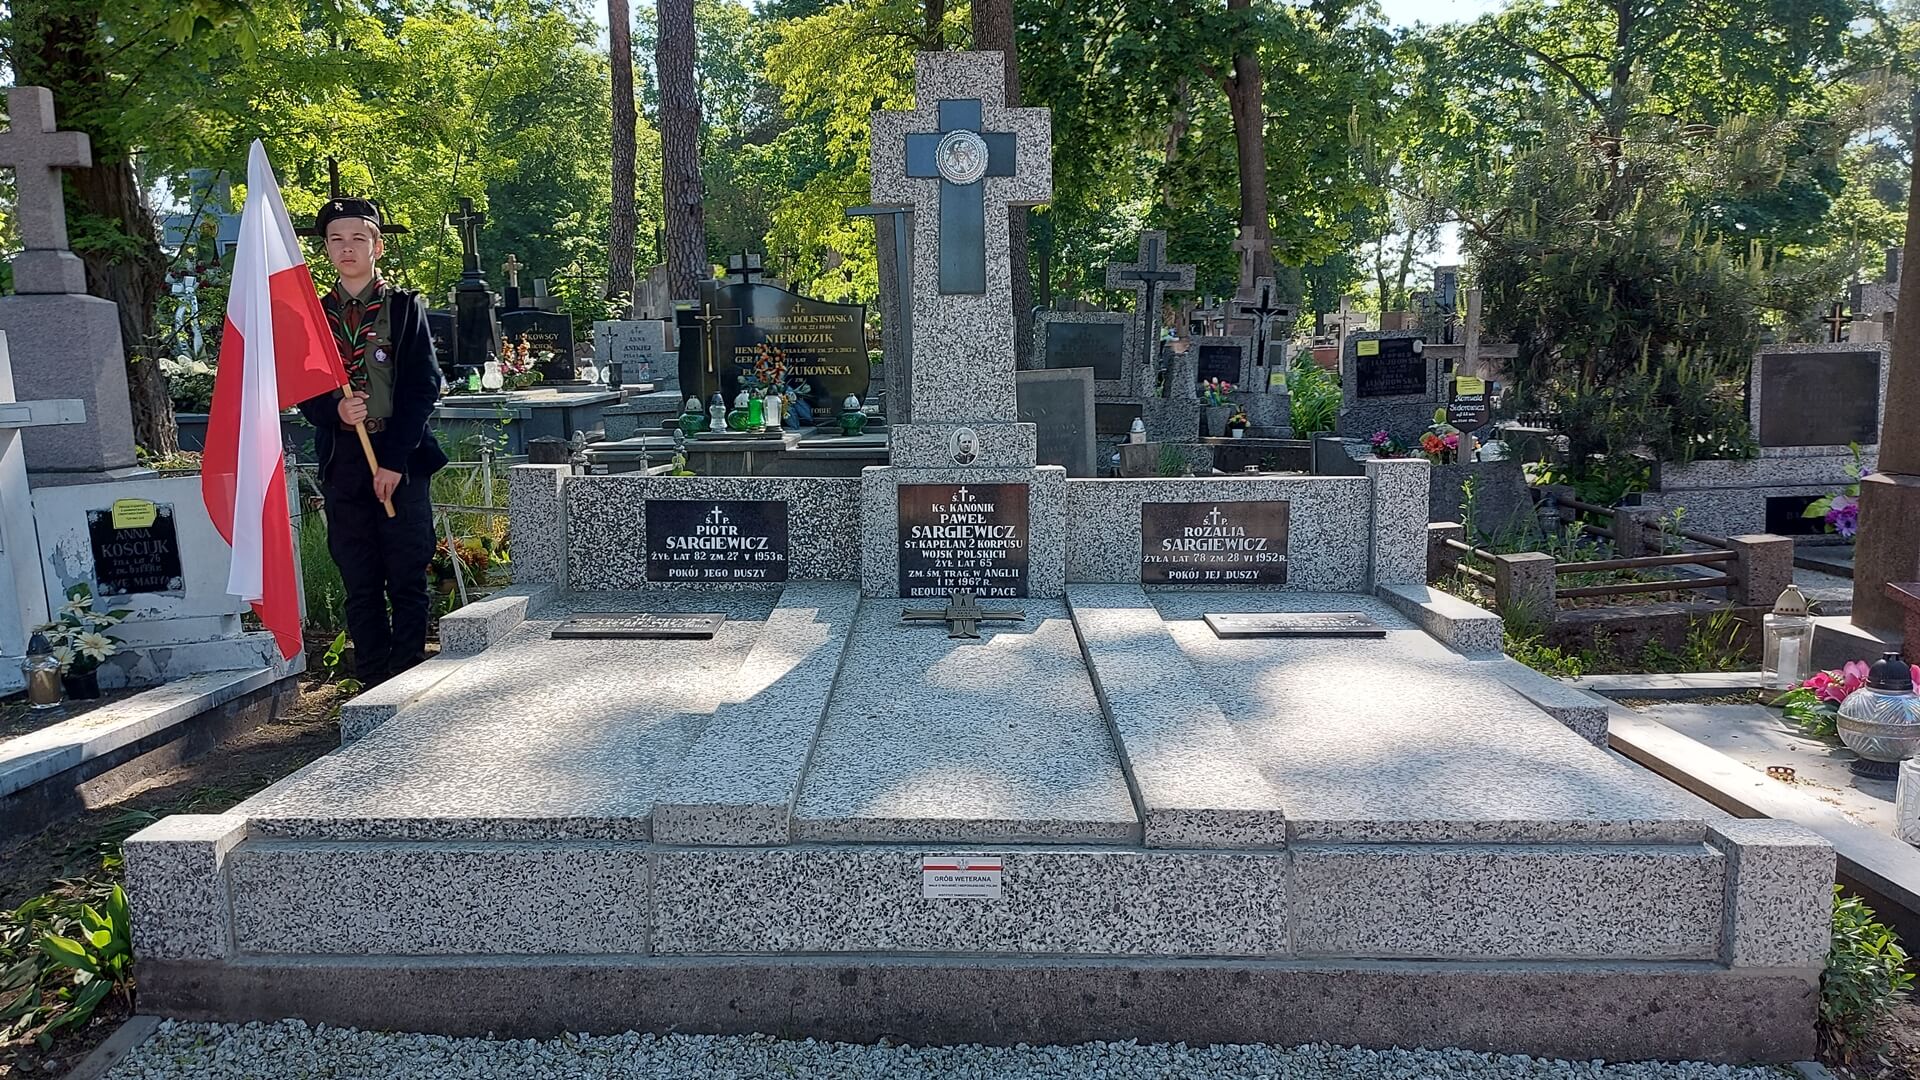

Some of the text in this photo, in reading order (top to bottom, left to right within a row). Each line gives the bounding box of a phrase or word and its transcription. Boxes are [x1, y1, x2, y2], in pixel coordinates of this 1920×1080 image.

[793, 314, 854, 323] DOLISTOWSKA
[765, 333, 834, 343] NIERODZIK
[734, 346, 778, 354] HENRKA
[950, 504, 994, 512] KANONIK
[940, 514, 986, 524] PAWEŁ
[116, 528, 152, 541] ANNA
[696, 525, 738, 536] PIOTR
[911, 525, 1016, 539] SARGIEWICZ
[1184, 526, 1246, 537] ROZALIA
[666, 536, 769, 550] SARGIEWICZ
[919, 540, 967, 548] KAPELAN
[968, 538, 975, 548] 2
[977, 540, 1024, 548] KORPUSU
[1162, 538, 1268, 552] SARGIEWICZ
[651, 552, 670, 560] ŻYŁ
[694, 552, 707, 560] 82
[727, 552, 739, 560] 27
[922, 550, 1006, 559] WOJSK POLSKICH
[1144, 554, 1170, 562] ŻYŁA
[1194, 553, 1206, 562] 78
[1227, 552, 1240, 562] 28
[935, 558, 992, 568] ŻYŁ LAT 65
[668, 564, 766, 578] POKÓJ JEGO DUSZY
[908, 568, 1020, 578] ZM. ŚM. TRAG. W ANGLII
[1168, 568, 1260, 580] POKÓJ JEJ DUSZY
[937, 578, 941, 586] 1
[944, 578, 954, 586] IX
[958, 577, 982, 586] 1967
[910, 587, 1016, 596] REQUIESCAT IN PACE
